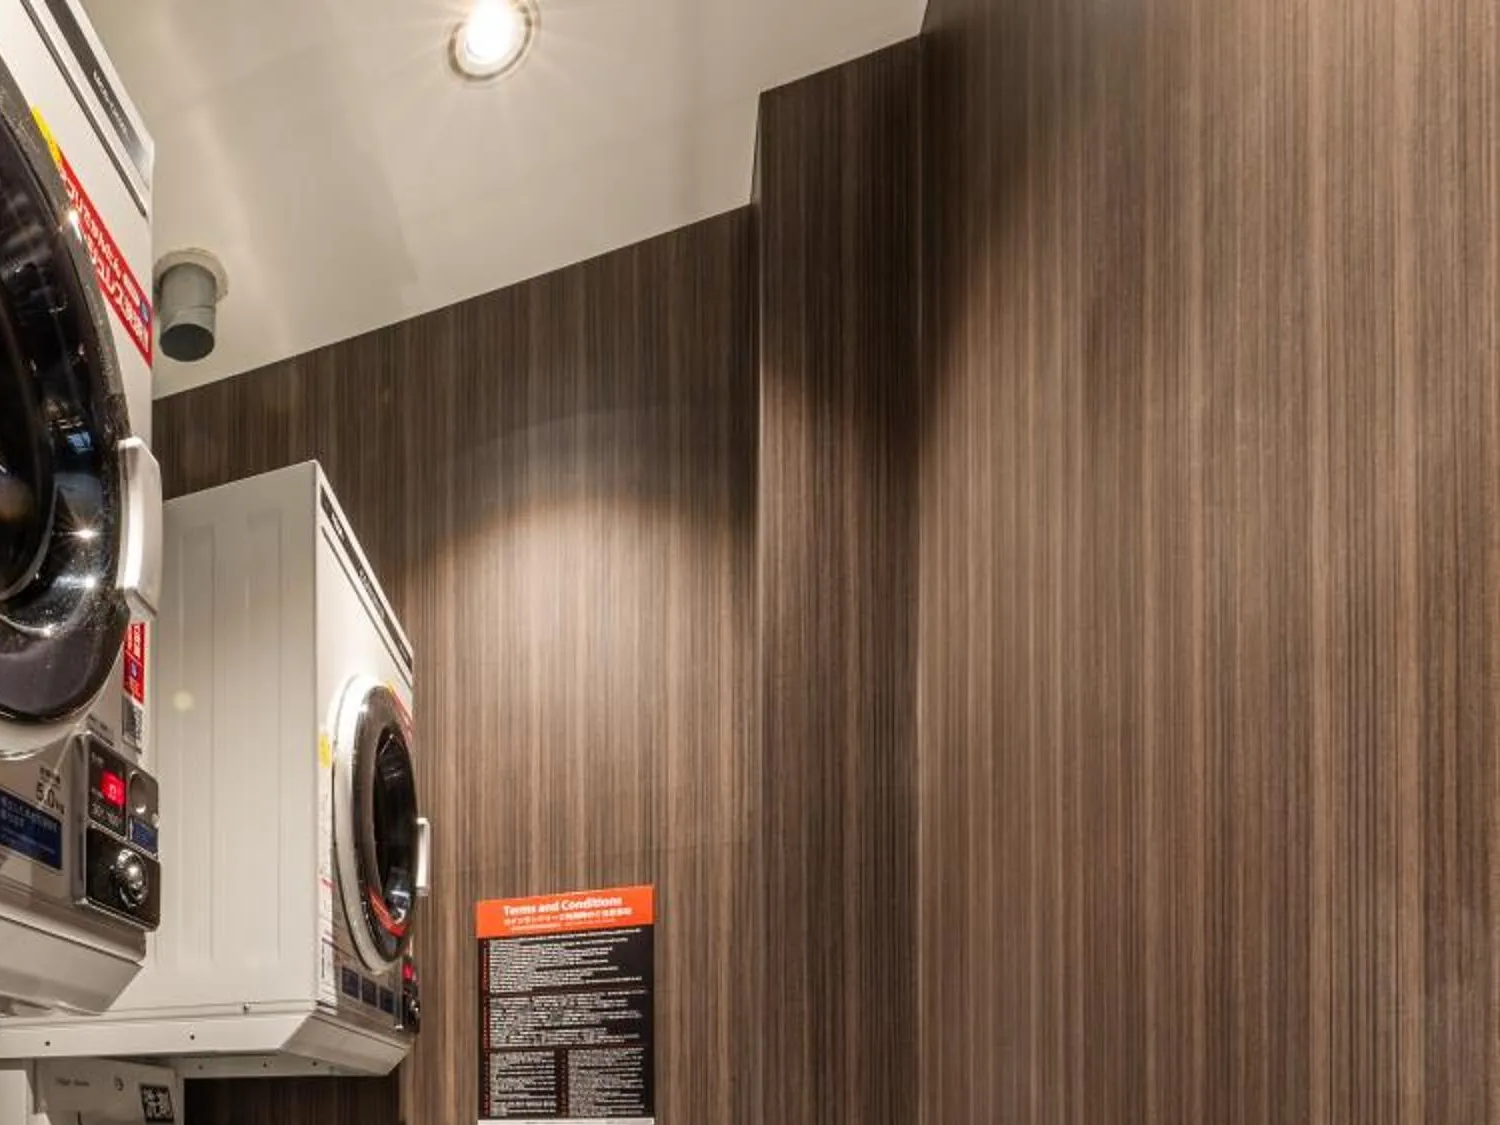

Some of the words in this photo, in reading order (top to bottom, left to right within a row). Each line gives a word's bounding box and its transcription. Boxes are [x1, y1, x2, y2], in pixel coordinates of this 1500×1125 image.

[503, 905, 536, 916] Terms
[538, 901, 560, 913] and
[561, 897, 623, 911] Conditions
